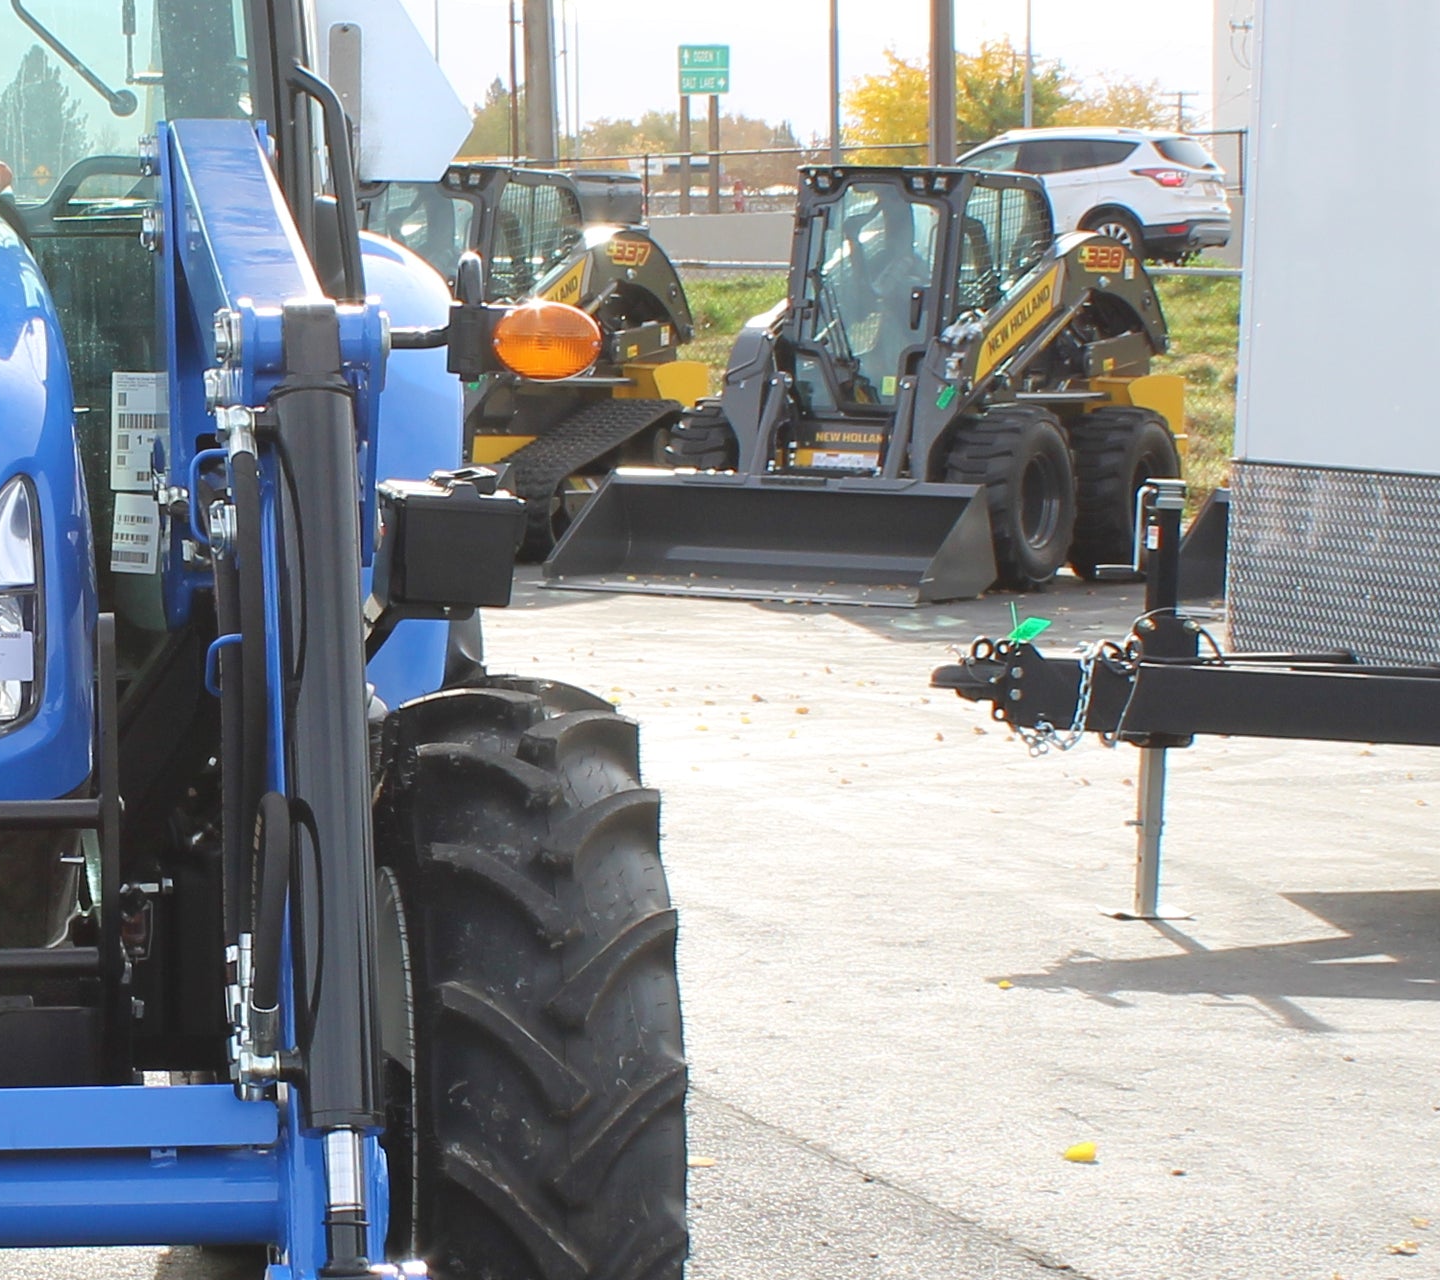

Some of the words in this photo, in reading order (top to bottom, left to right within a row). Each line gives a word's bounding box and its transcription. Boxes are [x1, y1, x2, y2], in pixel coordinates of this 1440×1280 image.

[553, 275, 579, 302] LAND
[987, 327, 1011, 356] NEW
[1010, 284, 1051, 335] HOLLAND
[815, 432, 840, 442] NEW
[842, 432, 884, 443] HOLLAN
